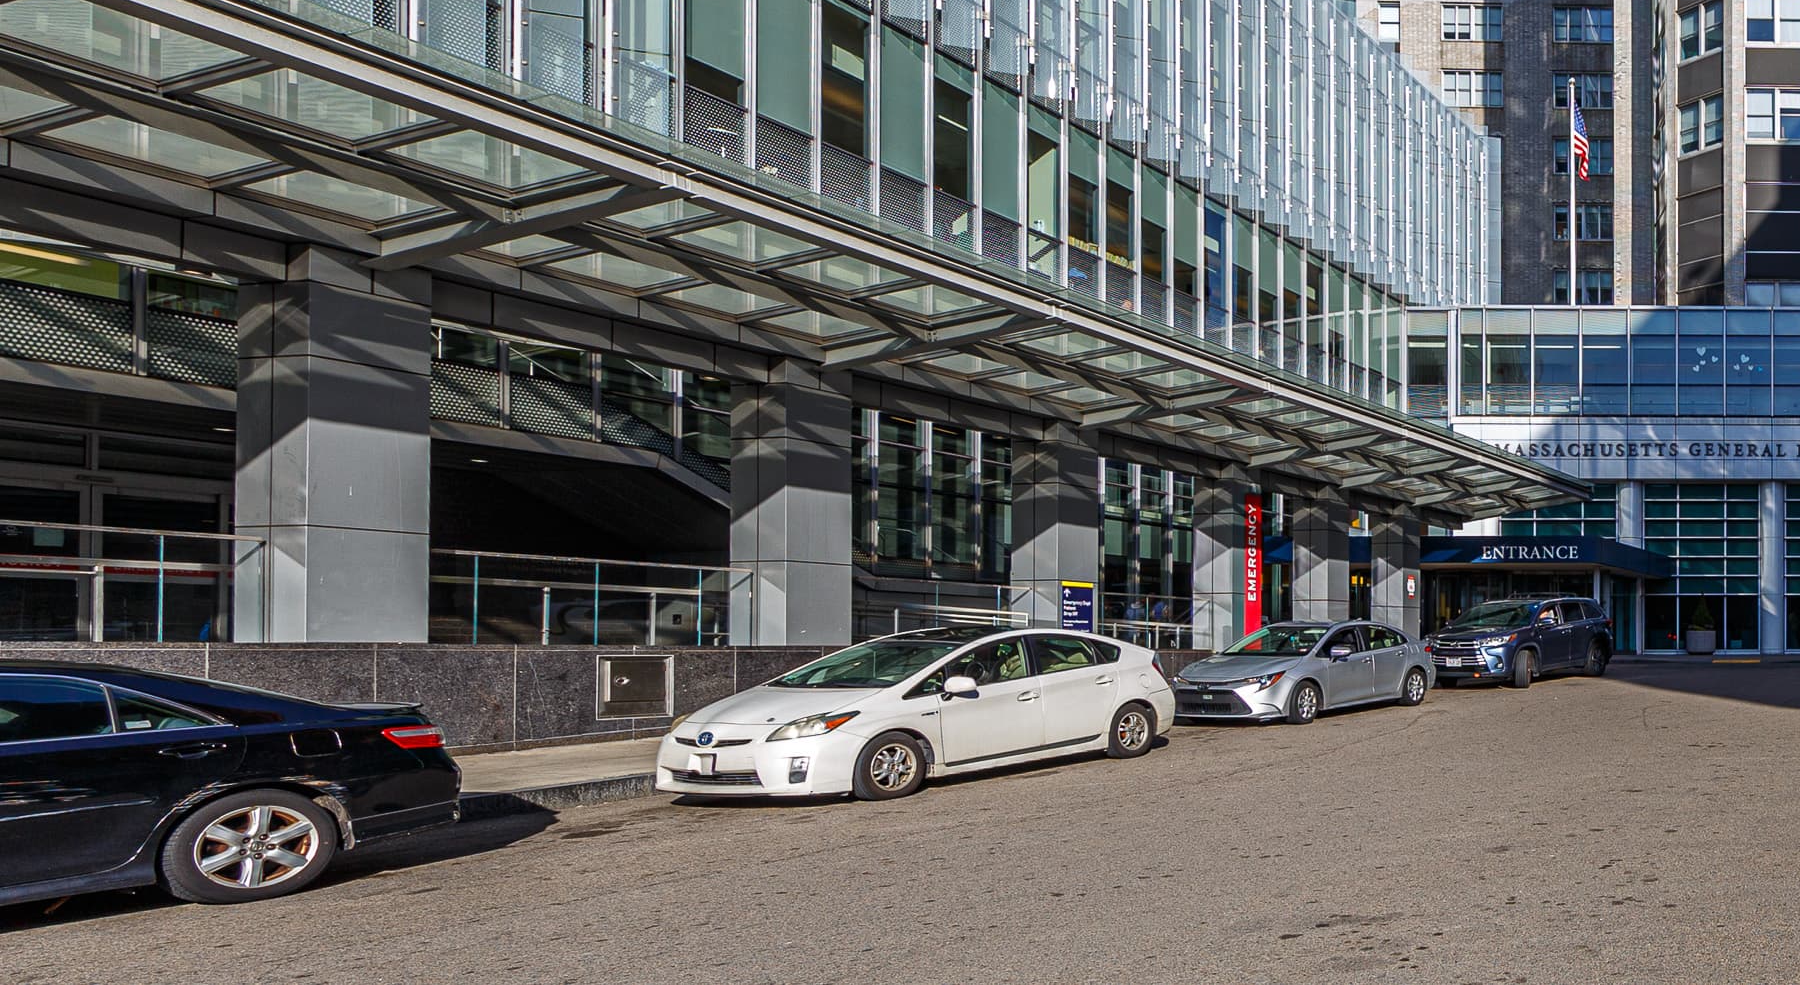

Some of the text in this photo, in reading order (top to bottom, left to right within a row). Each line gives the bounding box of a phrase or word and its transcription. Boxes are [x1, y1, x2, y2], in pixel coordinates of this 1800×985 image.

[1688, 443, 1787, 457] GENERAL
[1247, 503, 1257, 602] EMERGENCY
[1481, 545, 1579, 560] ENTRANCE
